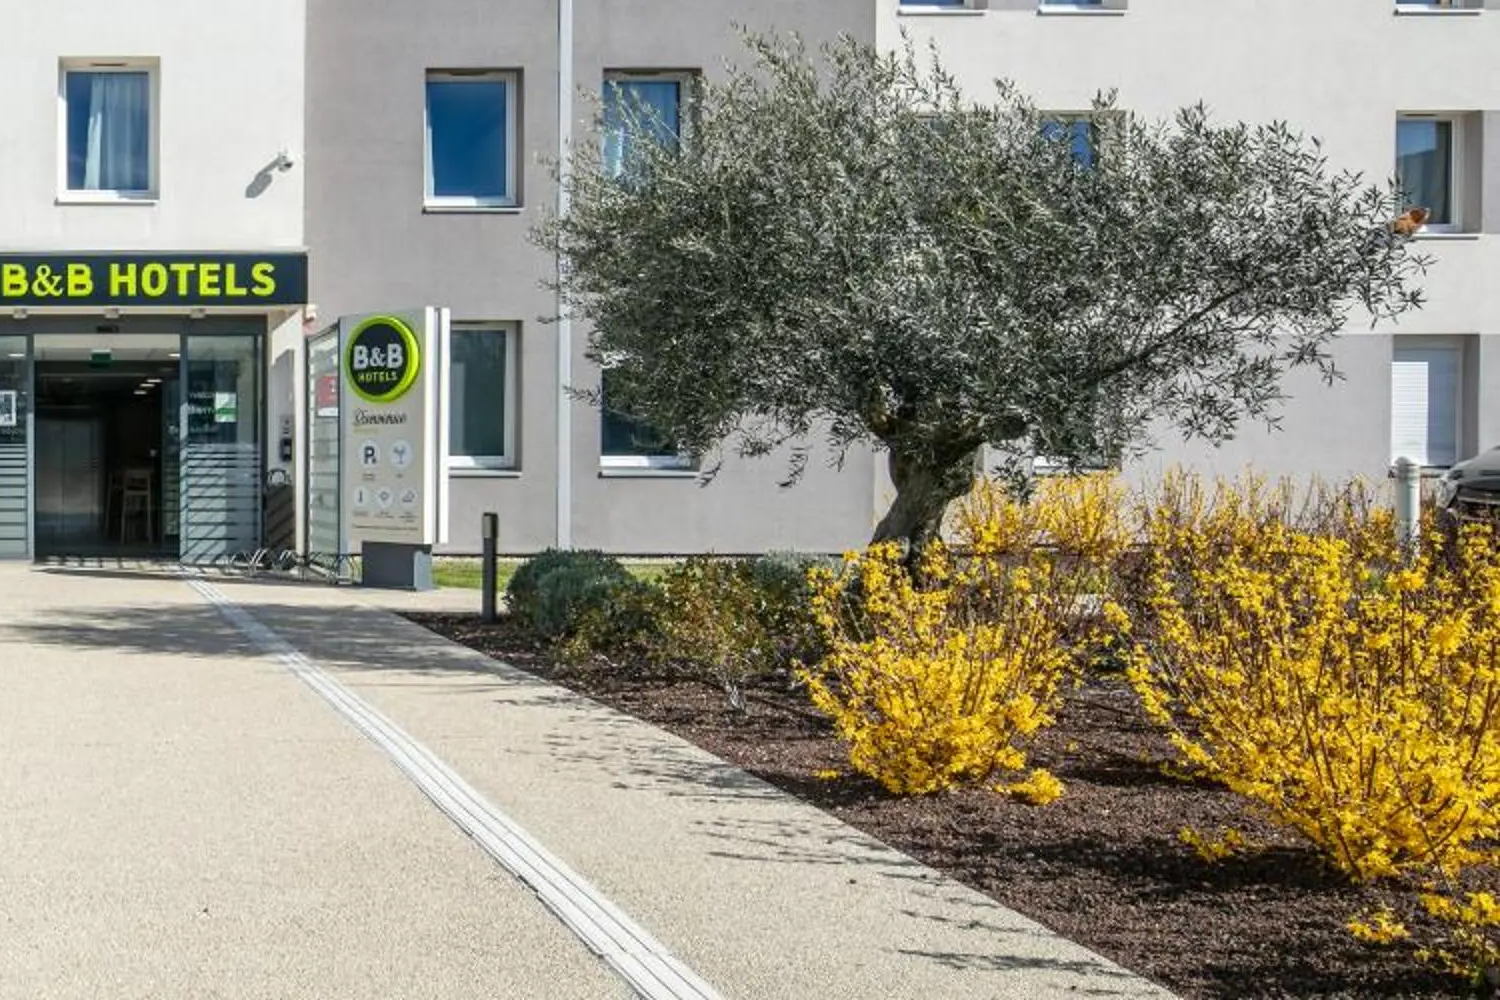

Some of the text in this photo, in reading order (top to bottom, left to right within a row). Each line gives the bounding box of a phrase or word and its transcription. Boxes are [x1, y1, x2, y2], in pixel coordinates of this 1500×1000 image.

[2, 263, 276, 298] B&B HOTELS
[353, 343, 404, 370] B&B
[357, 369, 398, 382] HOTELS
